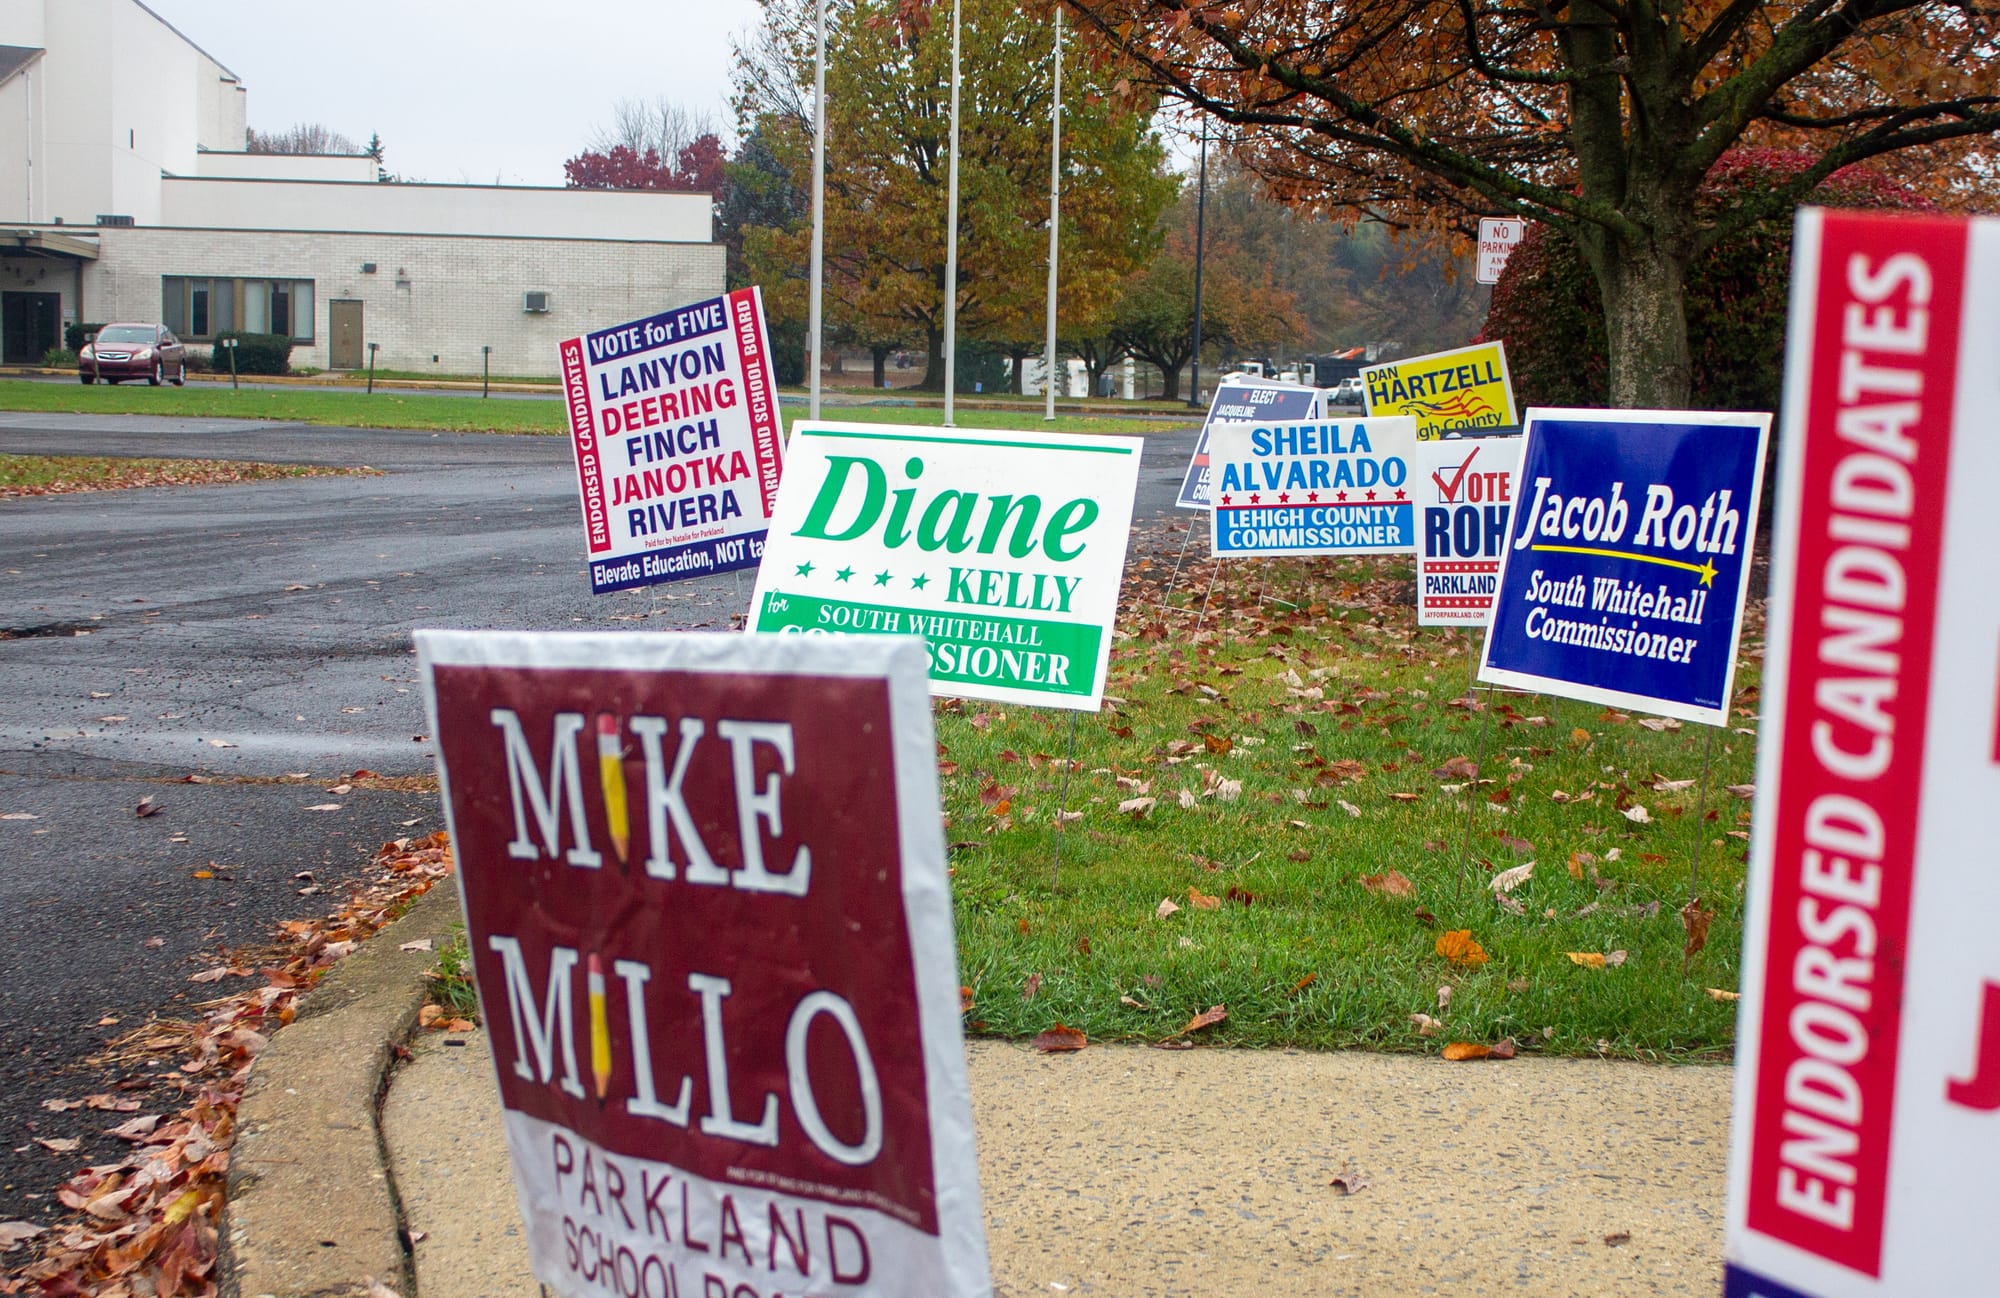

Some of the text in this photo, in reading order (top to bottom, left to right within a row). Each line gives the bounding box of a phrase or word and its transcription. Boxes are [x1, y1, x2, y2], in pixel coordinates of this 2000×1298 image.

[1493, 226, 1509, 239] NO
[590, 304, 723, 360] VOTE for FIVE
[737, 299, 758, 356] BOARD
[600, 342, 726, 401] LANYON
[746, 358, 769, 422] SCHOOL
[1366, 366, 1399, 384] DAN
[1369, 360, 1503, 407] HARTZELL
[601, 378, 737, 436] DEERING
[1216, 404, 1256, 418] JACQUELINE
[1250, 390, 1278, 405] ELECT
[566, 345, 606, 545] ENDORSED CANDIDATES
[626, 418, 720, 466] FINCH
[1250, 423, 1372, 457] SHEILA
[612, 450, 751, 506] JANOTKA
[1221, 456, 1407, 492] ALVARADO
[627, 489, 743, 538] RIVERA
[700, 526, 725, 538] Parkland
[791, 455, 1100, 563] Diane
[1228, 505, 1400, 529] LEHIGH COUNTY
[1513, 476, 1741, 555] Jacob Roth
[1228, 526, 1401, 548] COMMISSIONER
[593, 558, 641, 587] Elevate
[642, 549, 713, 577] Education,
[715, 539, 746, 564] NOT
[1425, 575, 1496, 595] PARKLAND
[767, 588, 789, 613] for
[944, 567, 1083, 613] KELLY
[1525, 569, 1708, 625] South Whitehall
[817, 604, 1042, 647] SOUTH WHITEHALL
[1525, 607, 1697, 665] Commissioner
[1776, 252, 1933, 1232] ENDORSED CANDIDATES
[553, 1133, 871, 1286] PARKLAND
